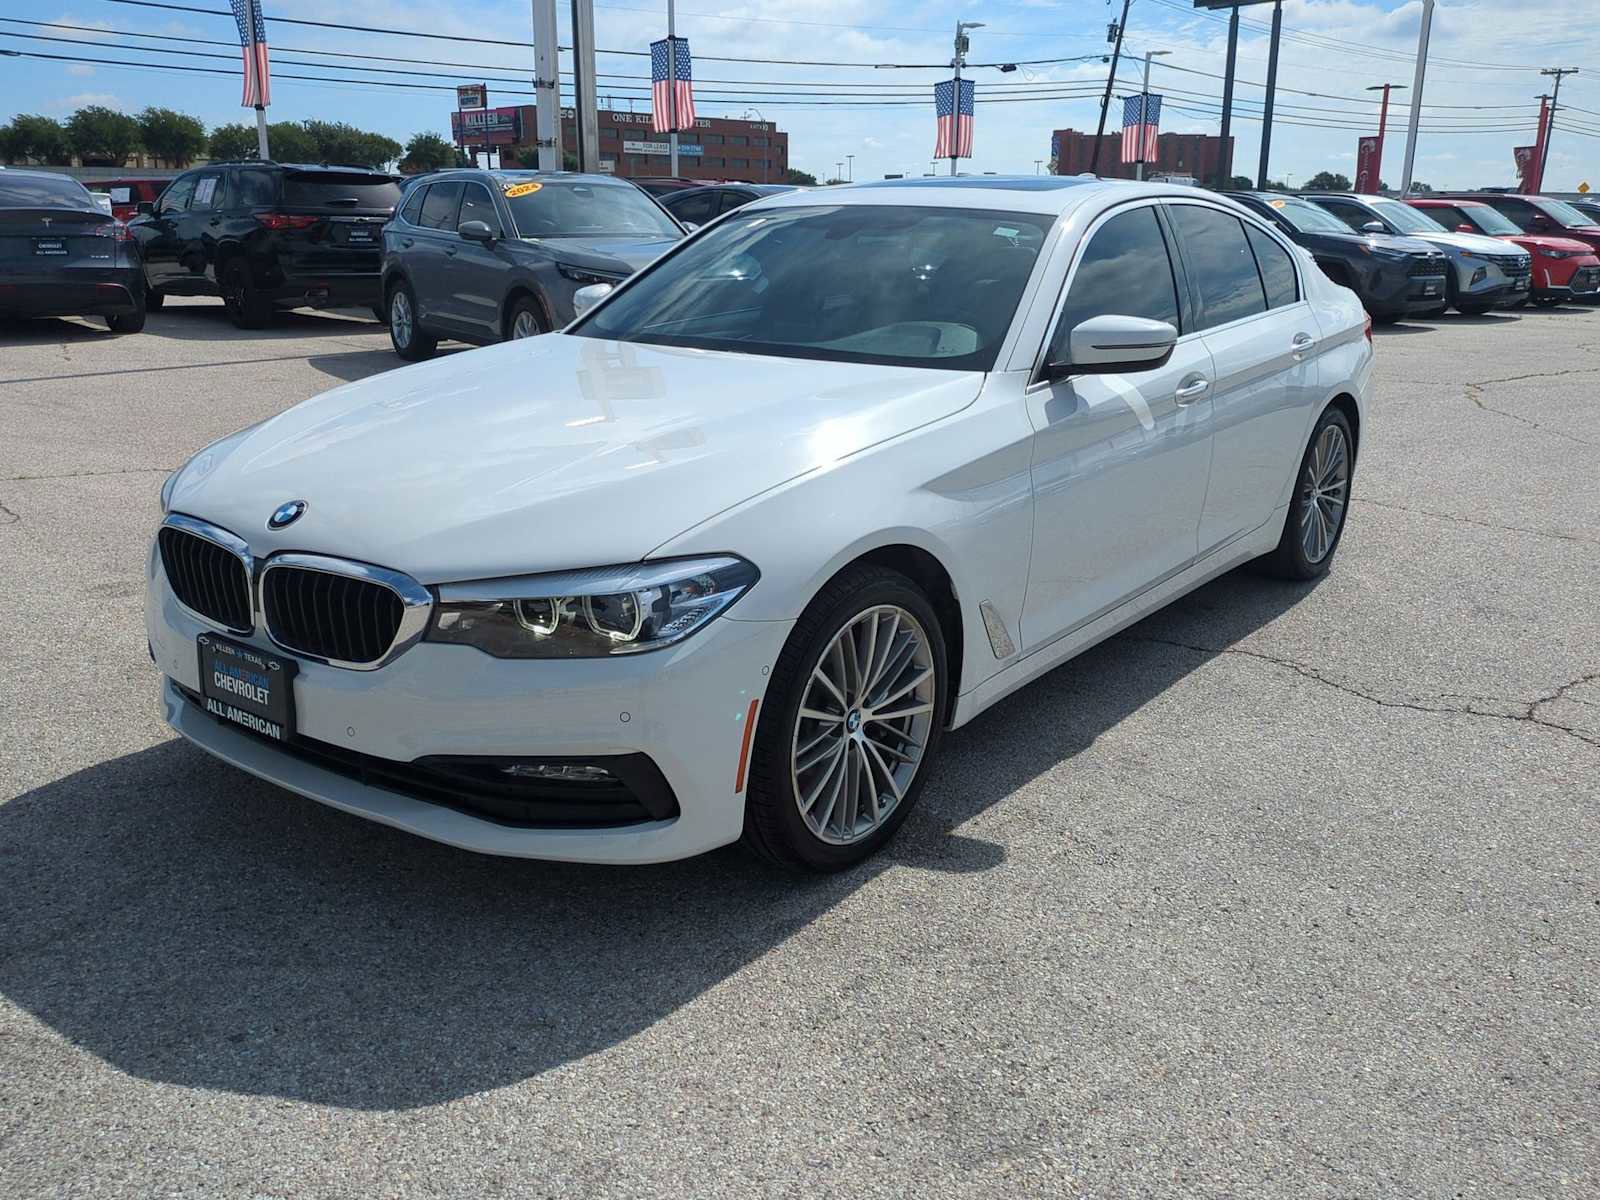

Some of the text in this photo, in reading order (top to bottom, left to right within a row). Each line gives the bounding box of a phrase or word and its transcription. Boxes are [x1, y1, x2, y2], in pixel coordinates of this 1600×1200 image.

[612, 113, 633, 123] ONE
[244, 653, 262, 666] TEXAS
[214, 671, 270, 705] CHEVROLET
[207, 698, 281, 740] ALL AMERICAN
